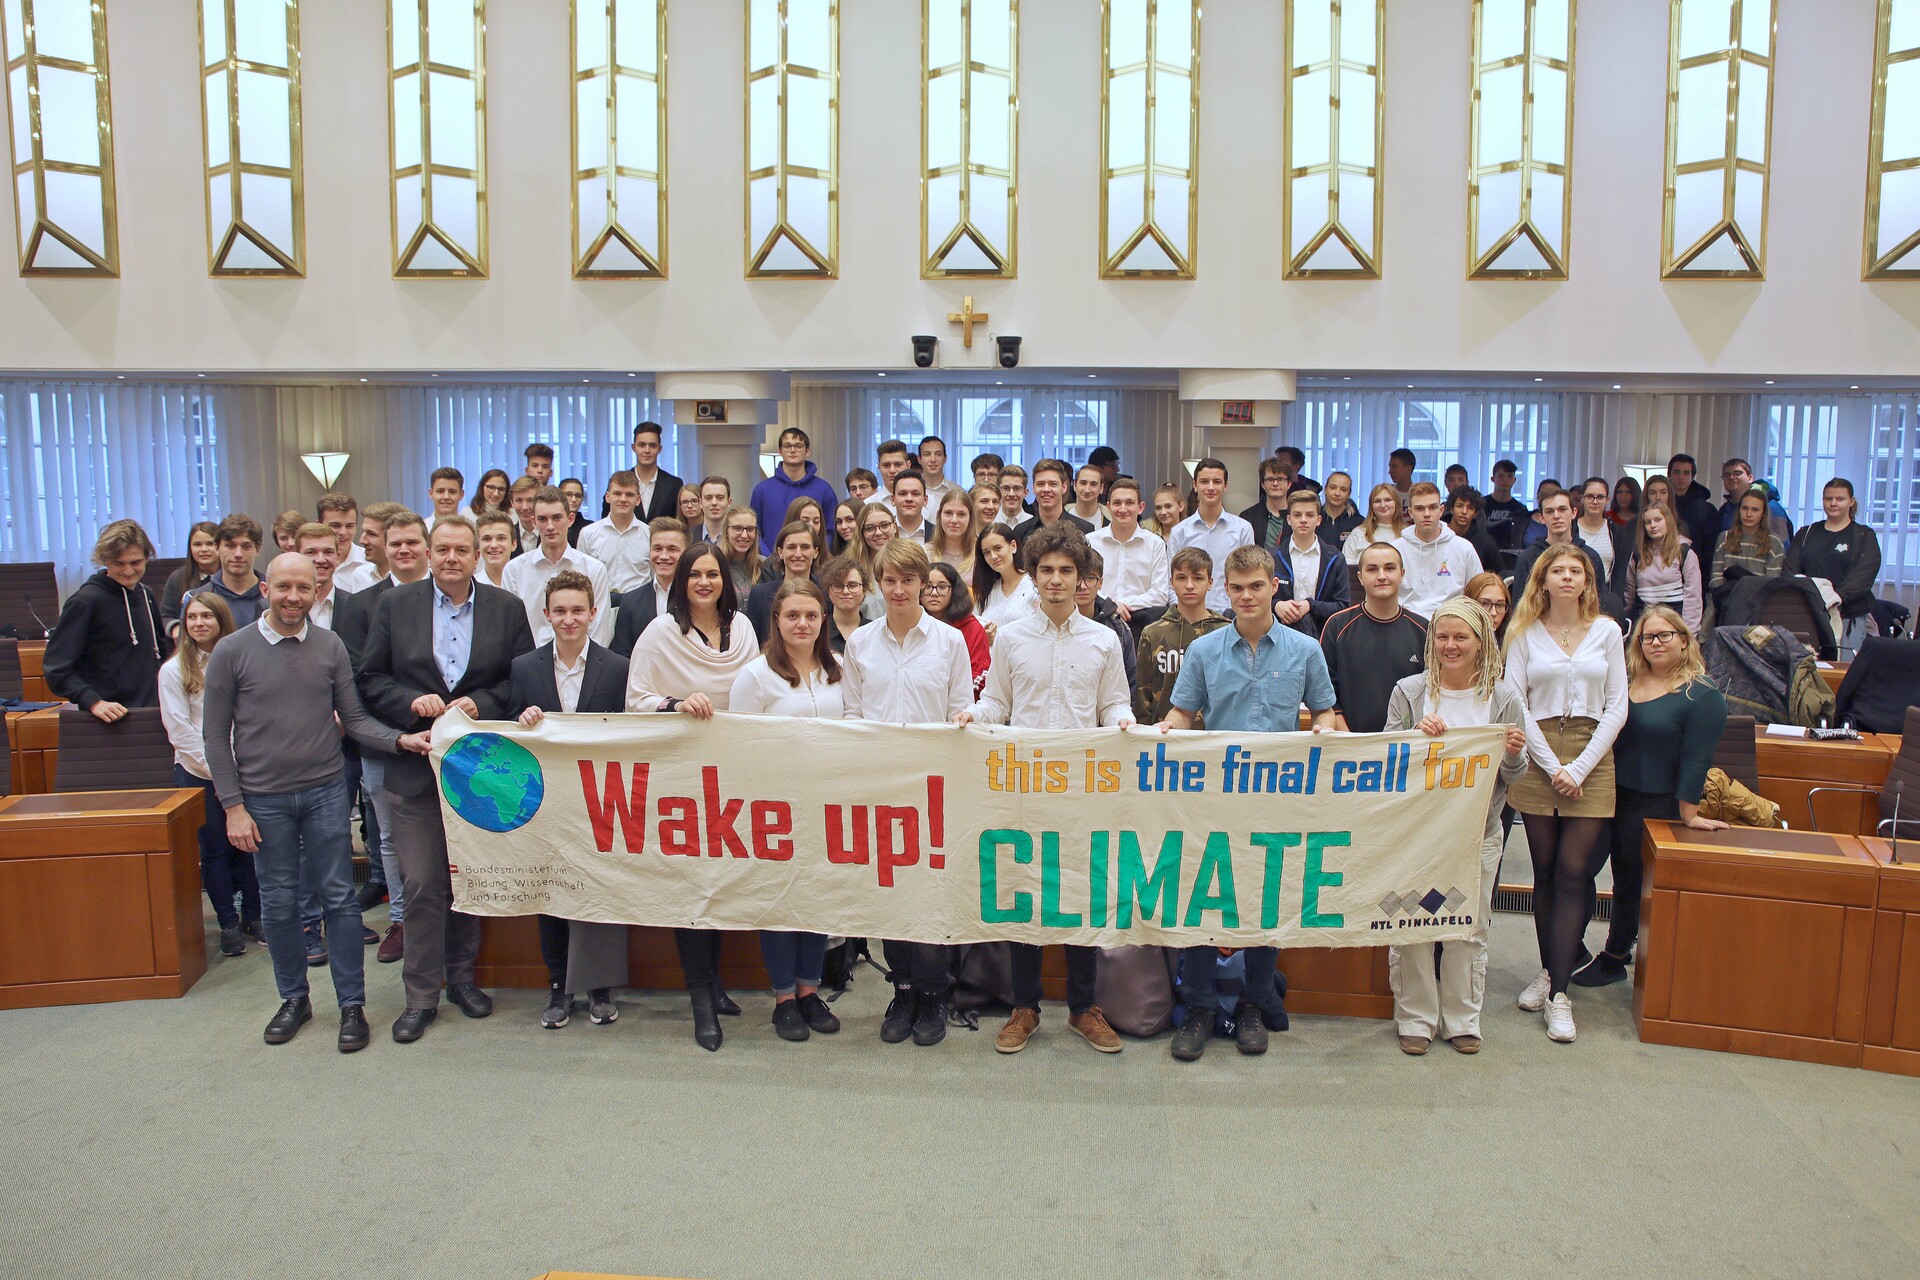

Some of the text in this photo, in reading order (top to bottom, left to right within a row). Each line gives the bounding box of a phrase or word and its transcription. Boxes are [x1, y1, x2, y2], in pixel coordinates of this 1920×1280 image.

[1490, 510, 1511, 520] NIKE
[984, 741, 1491, 795] this is the final call for
[577, 759, 945, 888] Wake up!
[465, 864, 568, 876] Bundesministerium
[514, 878, 585, 891] Wissenschaft
[978, 829, 1352, 931] CLIMATE
[470, 892, 551, 902] und Forschung
[1370, 915, 1473, 930] HTL PINKAFELD
